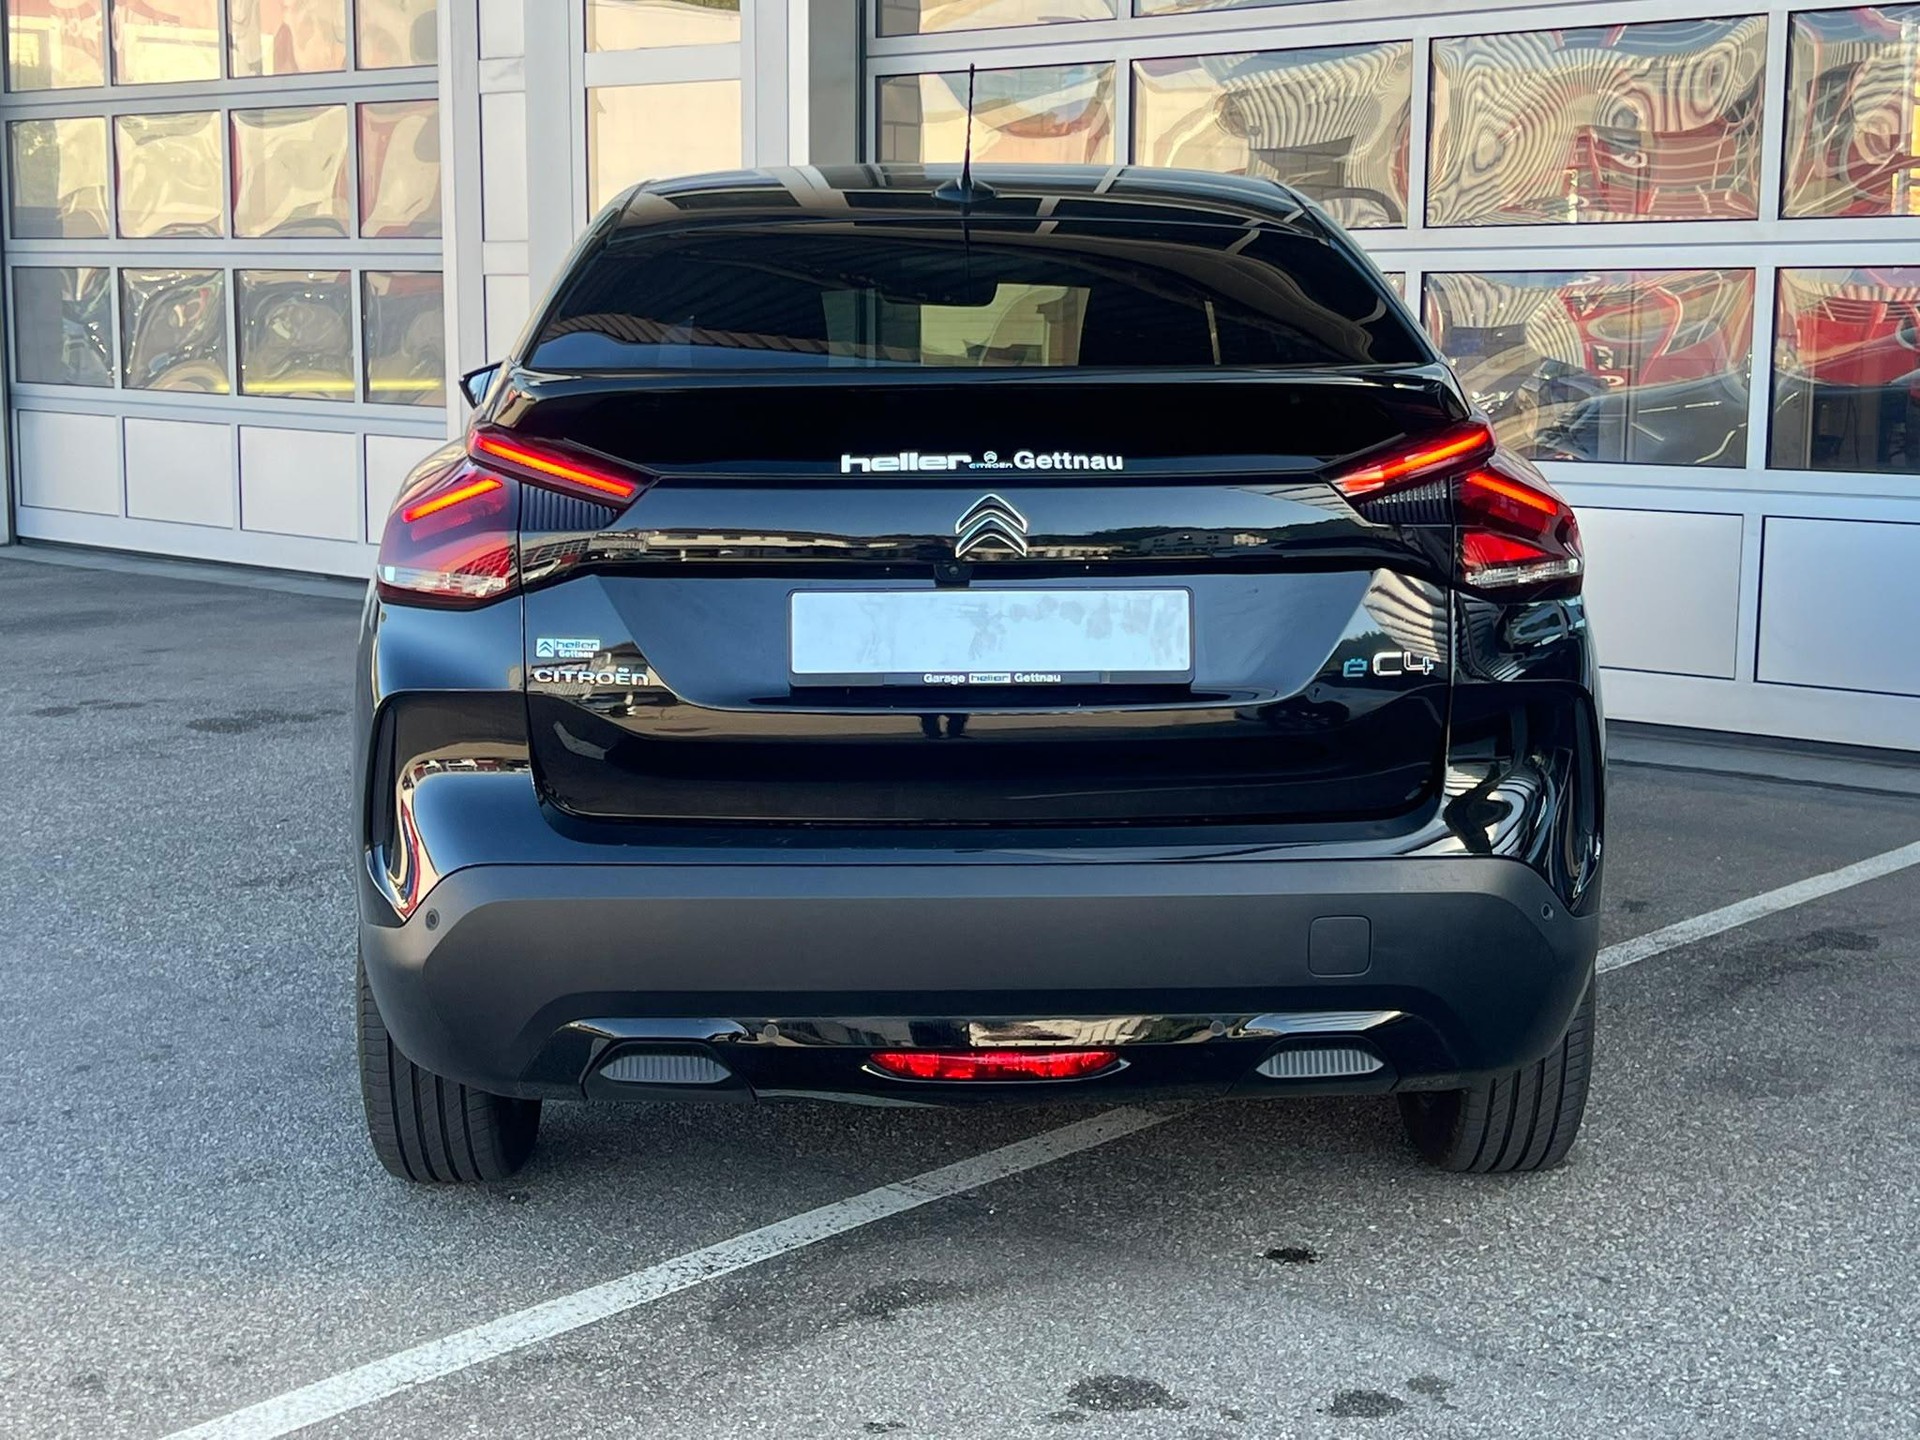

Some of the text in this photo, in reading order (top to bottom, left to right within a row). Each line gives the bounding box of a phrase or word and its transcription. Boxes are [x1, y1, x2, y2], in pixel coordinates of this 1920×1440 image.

[841, 452, 971, 473] heller
[1013, 450, 1123, 470] Gettnau
[555, 641, 598, 649] heller
[1372, 651, 1434, 676] C4
[923, 673, 1061, 685] Garage heller Gettnau
